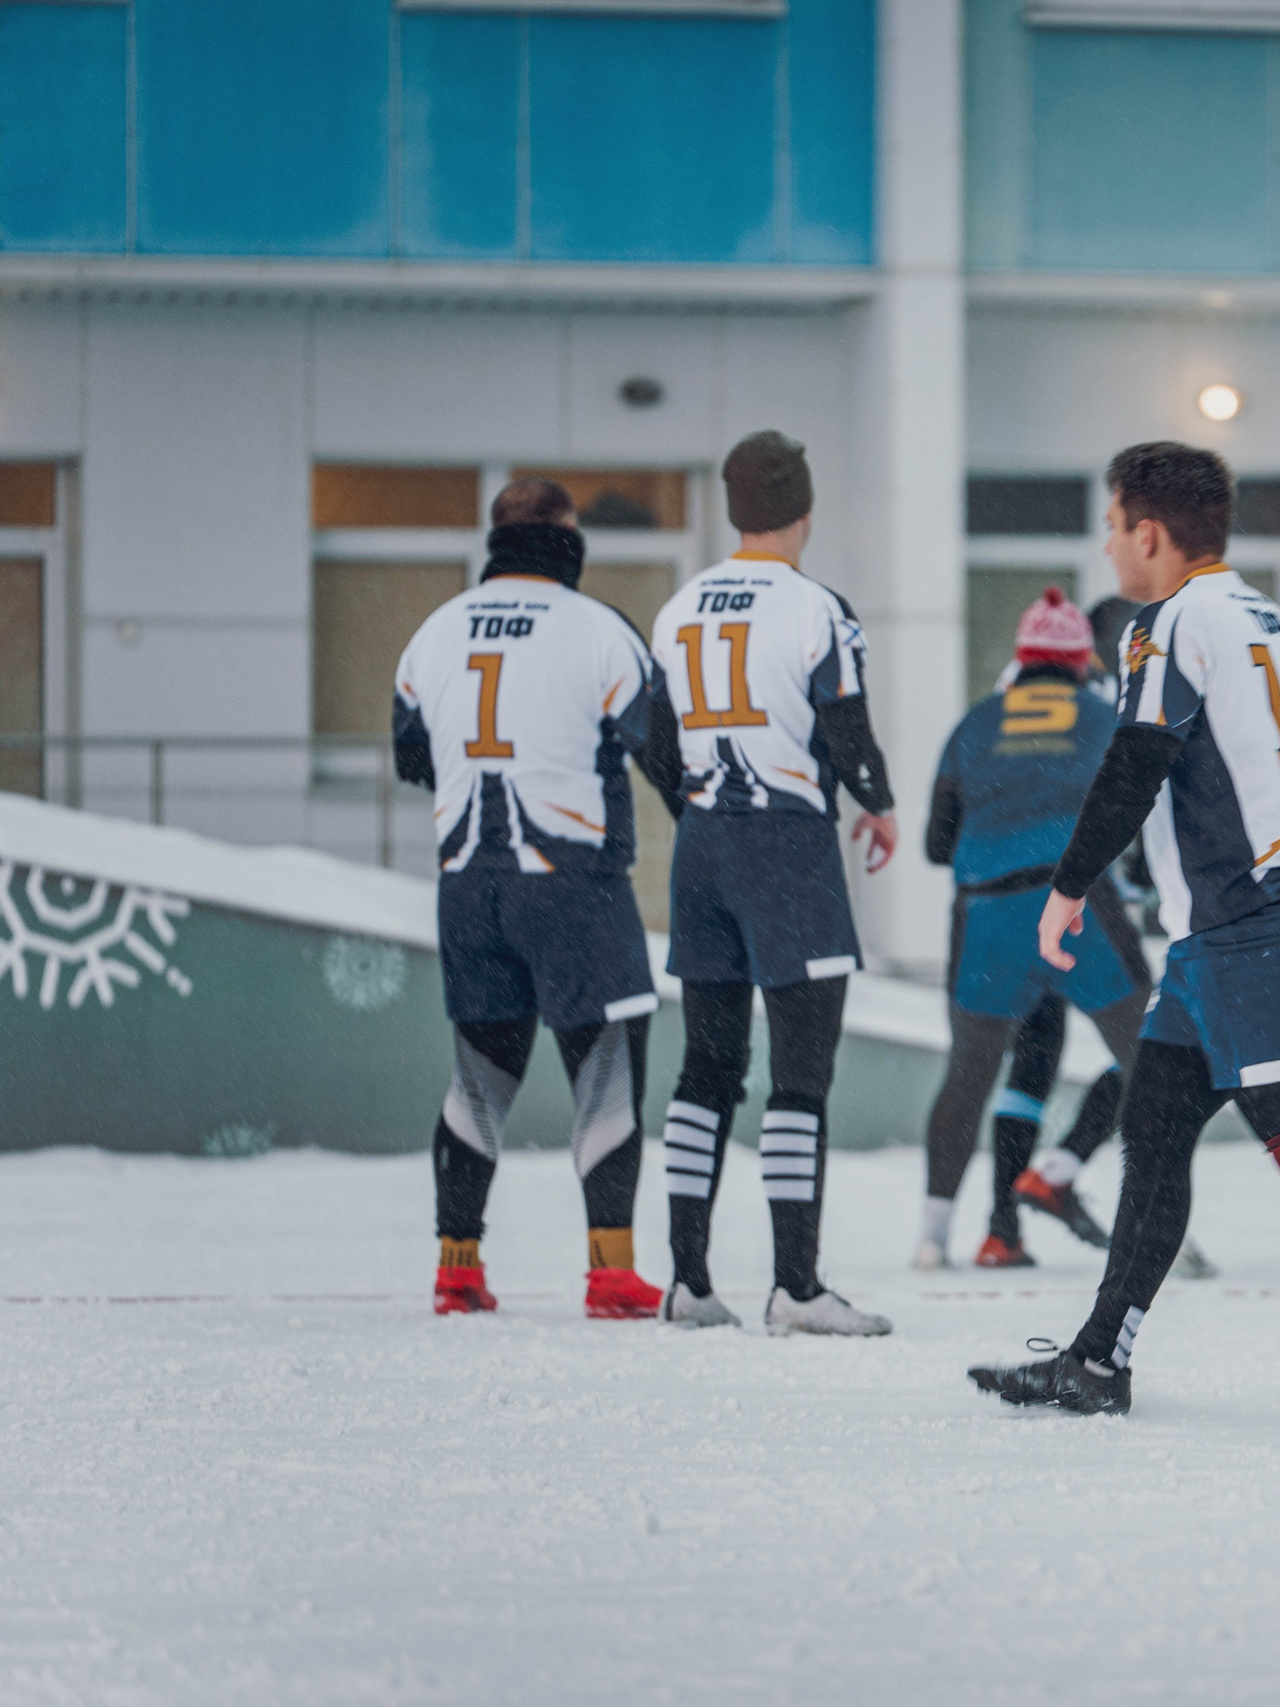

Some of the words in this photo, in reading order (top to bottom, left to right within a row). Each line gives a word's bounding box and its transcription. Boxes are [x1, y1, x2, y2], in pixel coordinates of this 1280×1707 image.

[470, 615, 534, 639] ТОФ
[697, 592, 756, 613] ТОФ
[465, 652, 514, 759] 1
[676, 622, 769, 730] 11
